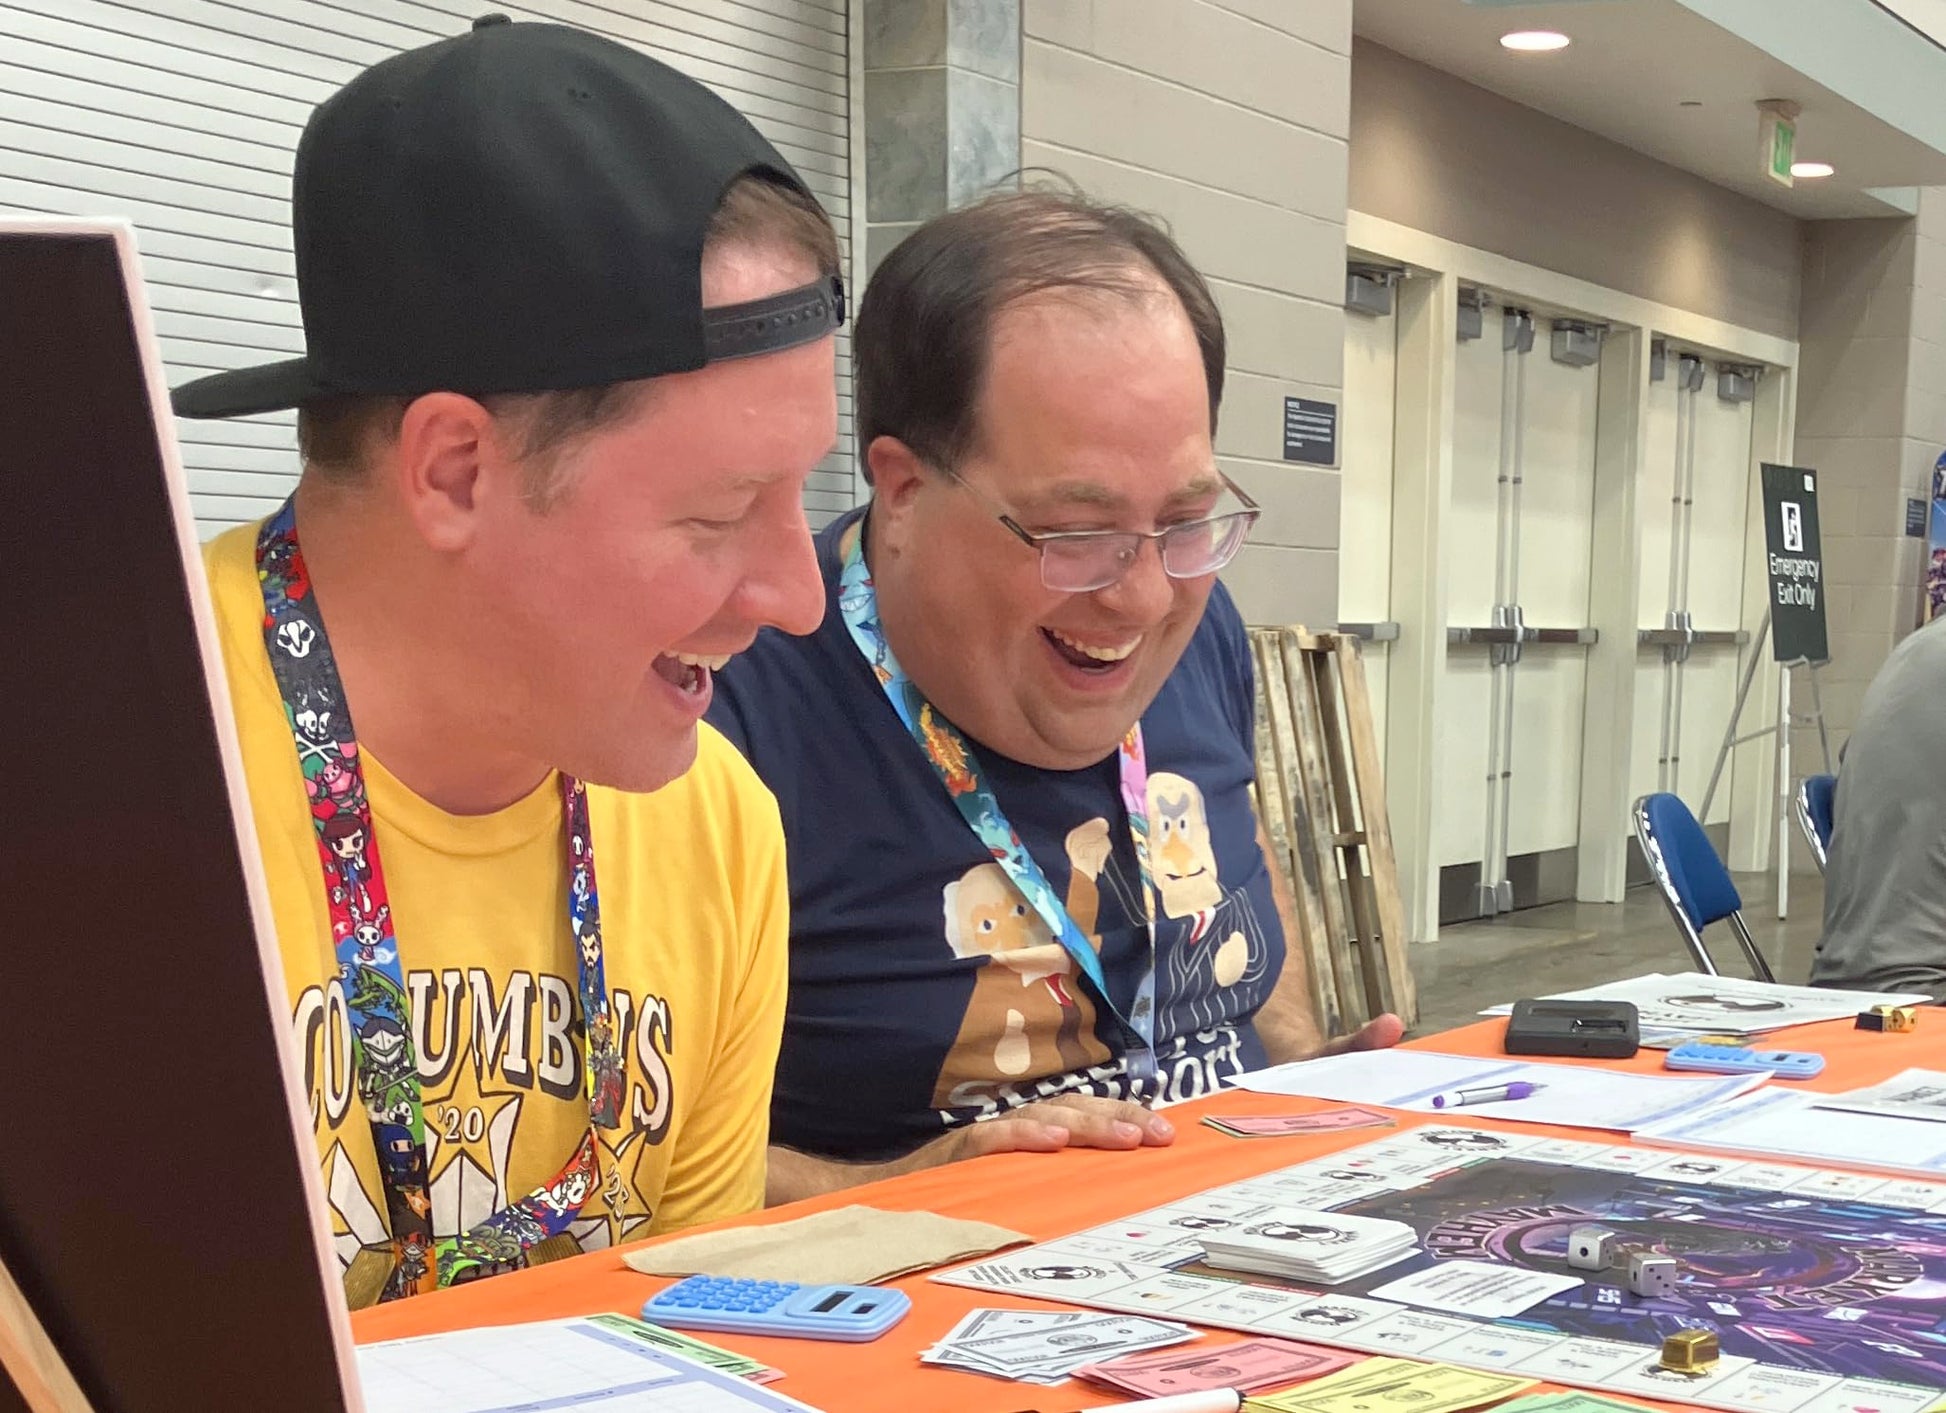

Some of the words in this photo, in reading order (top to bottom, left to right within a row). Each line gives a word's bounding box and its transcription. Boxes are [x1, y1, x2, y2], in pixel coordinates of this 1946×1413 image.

[1769, 552, 1820, 582] Emergency
[1776, 582, 1796, 606] Exit
[1795, 583, 1816, 611] Only
[293, 967, 673, 1146] COUMBS
[1423, 1203, 1590, 1261] MAYHEM
